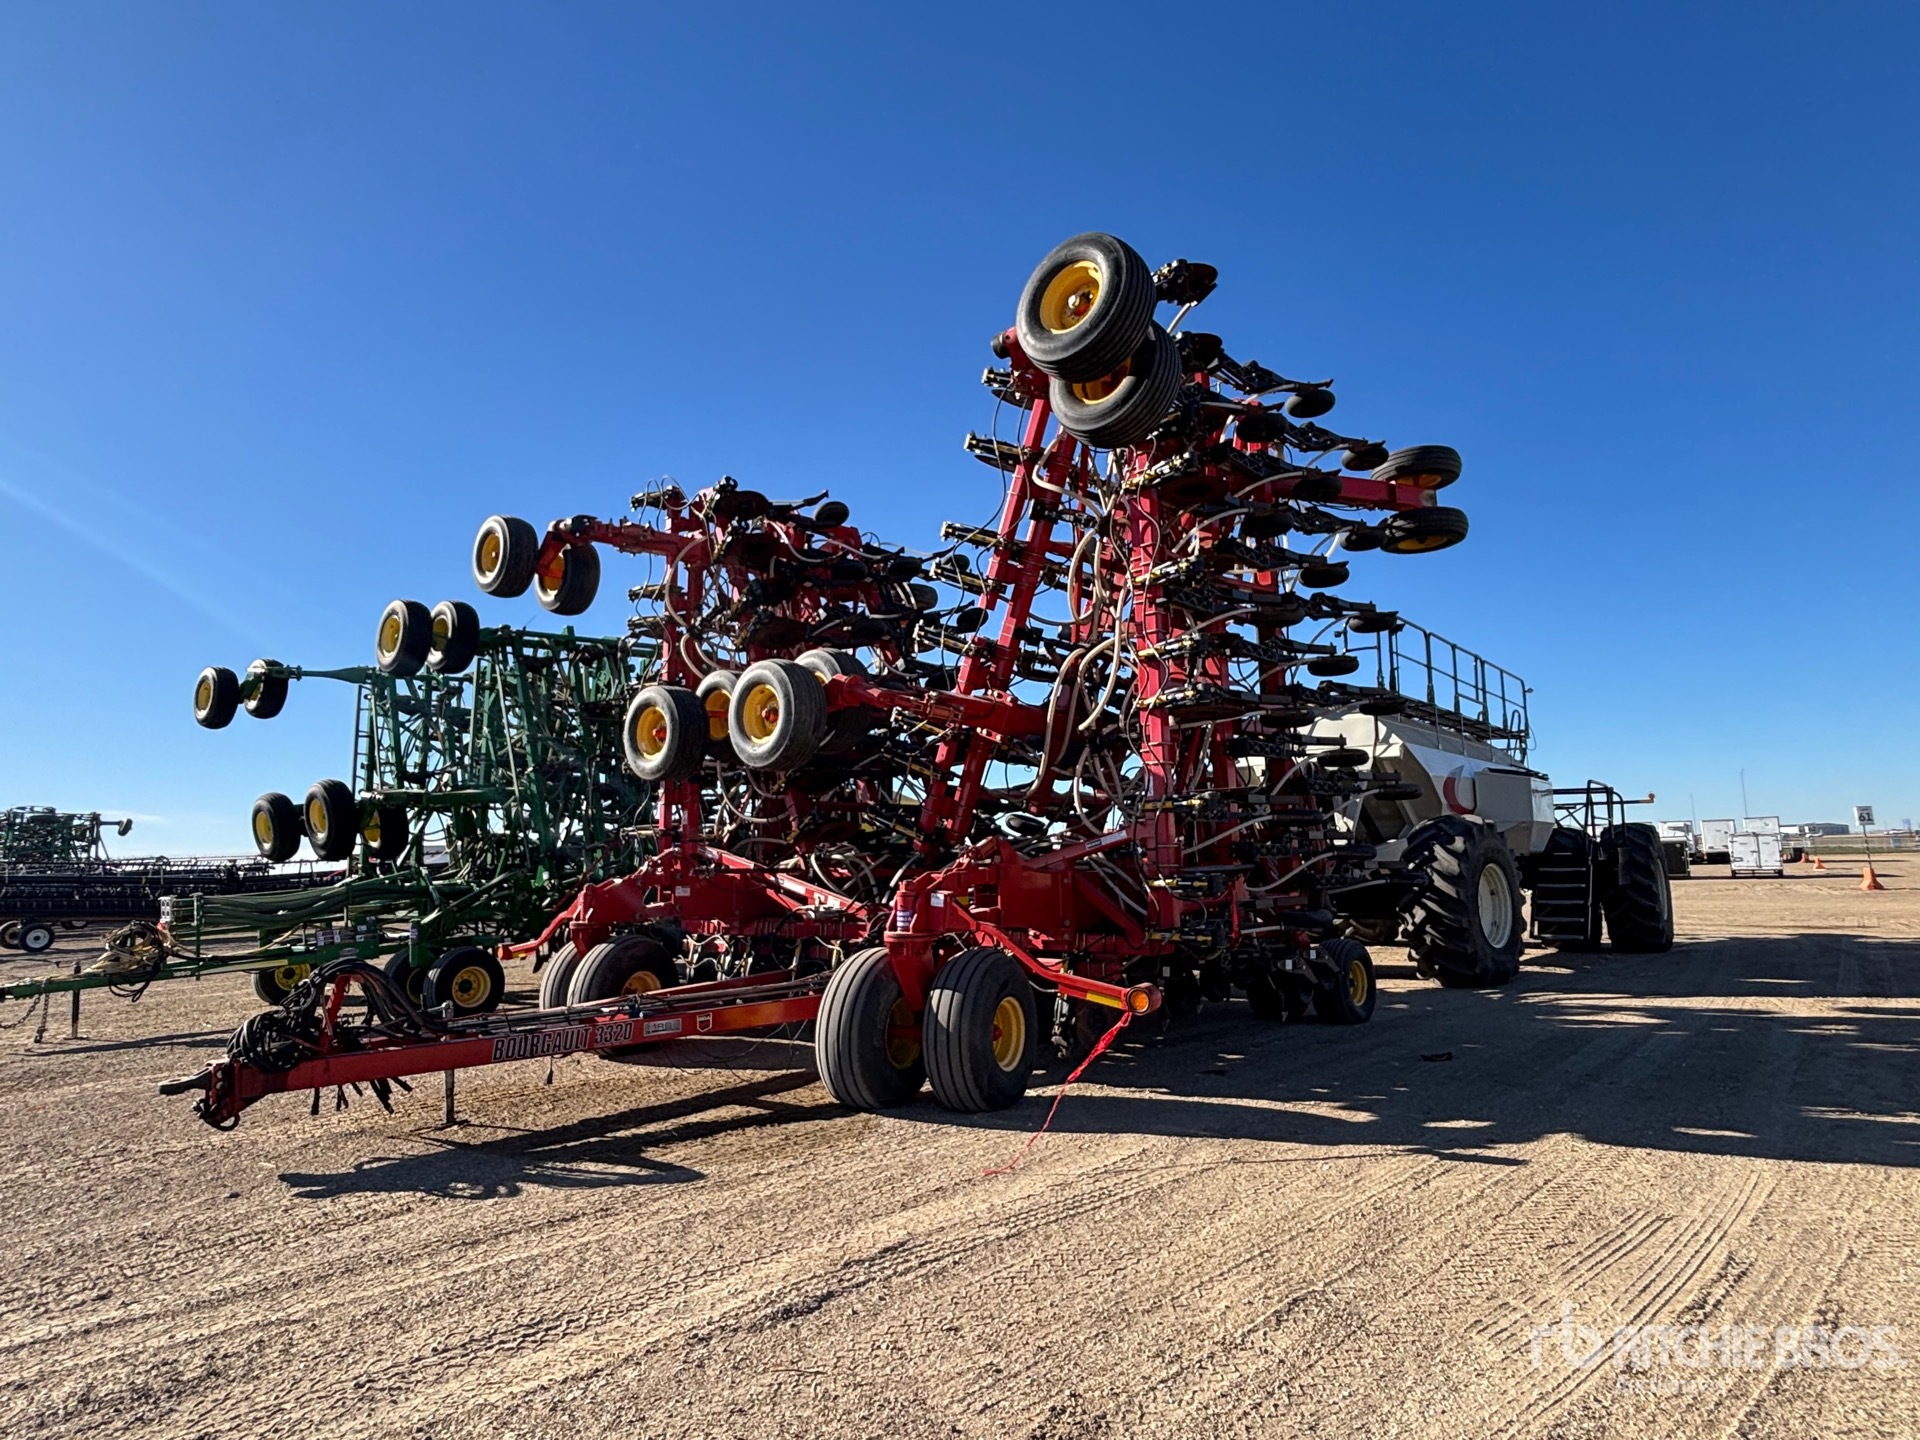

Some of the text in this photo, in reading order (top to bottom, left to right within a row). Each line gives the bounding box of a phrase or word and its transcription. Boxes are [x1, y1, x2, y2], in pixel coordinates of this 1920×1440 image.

[1858, 812, 1873, 822] 61
[492, 1021, 634, 1062] BOURGAULT 3320
